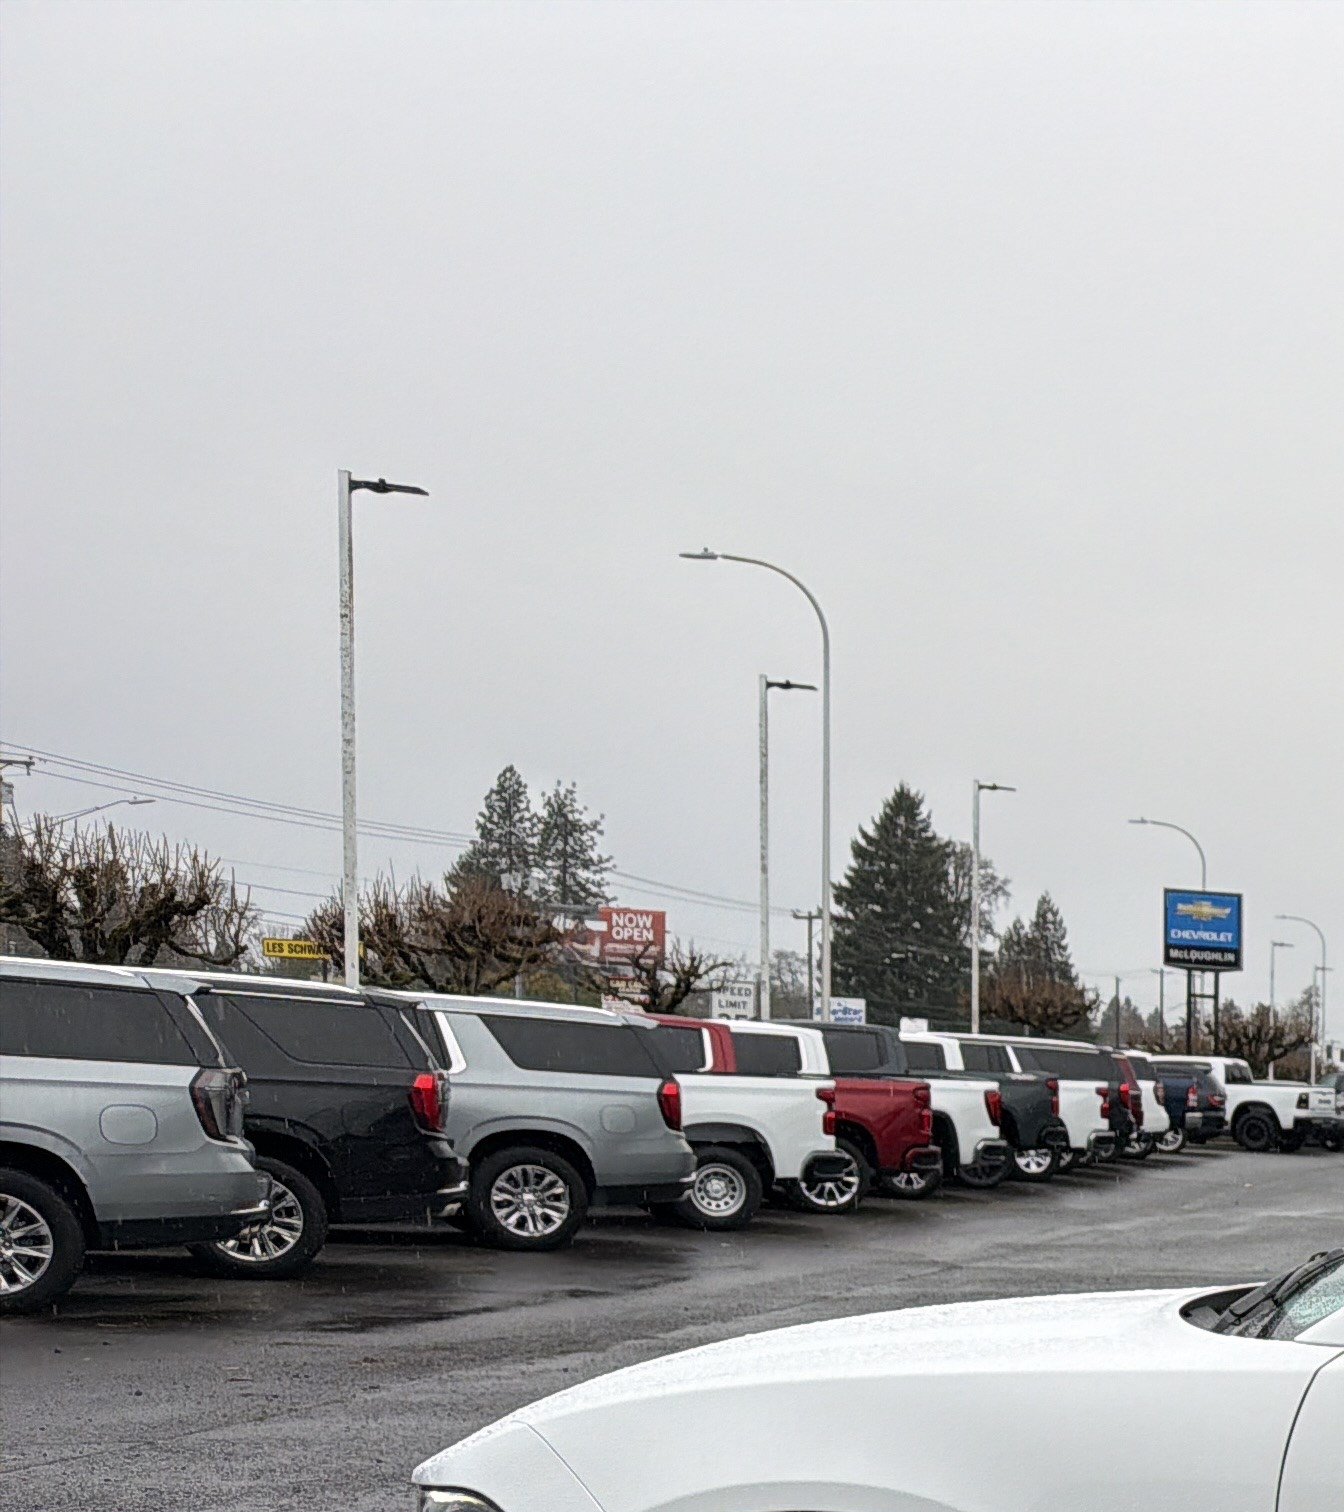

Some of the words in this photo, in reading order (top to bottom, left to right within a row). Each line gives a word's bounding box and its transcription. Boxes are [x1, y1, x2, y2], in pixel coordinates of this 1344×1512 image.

[611, 912, 653, 928] NOW
[611, 927, 654, 941] OPEN
[1170, 928, 1233, 943] CHEVROLET
[266, 942, 285, 954] LES
[287, 942, 328, 956] SCHWA
[717, 999, 748, 1009] LIMIT
